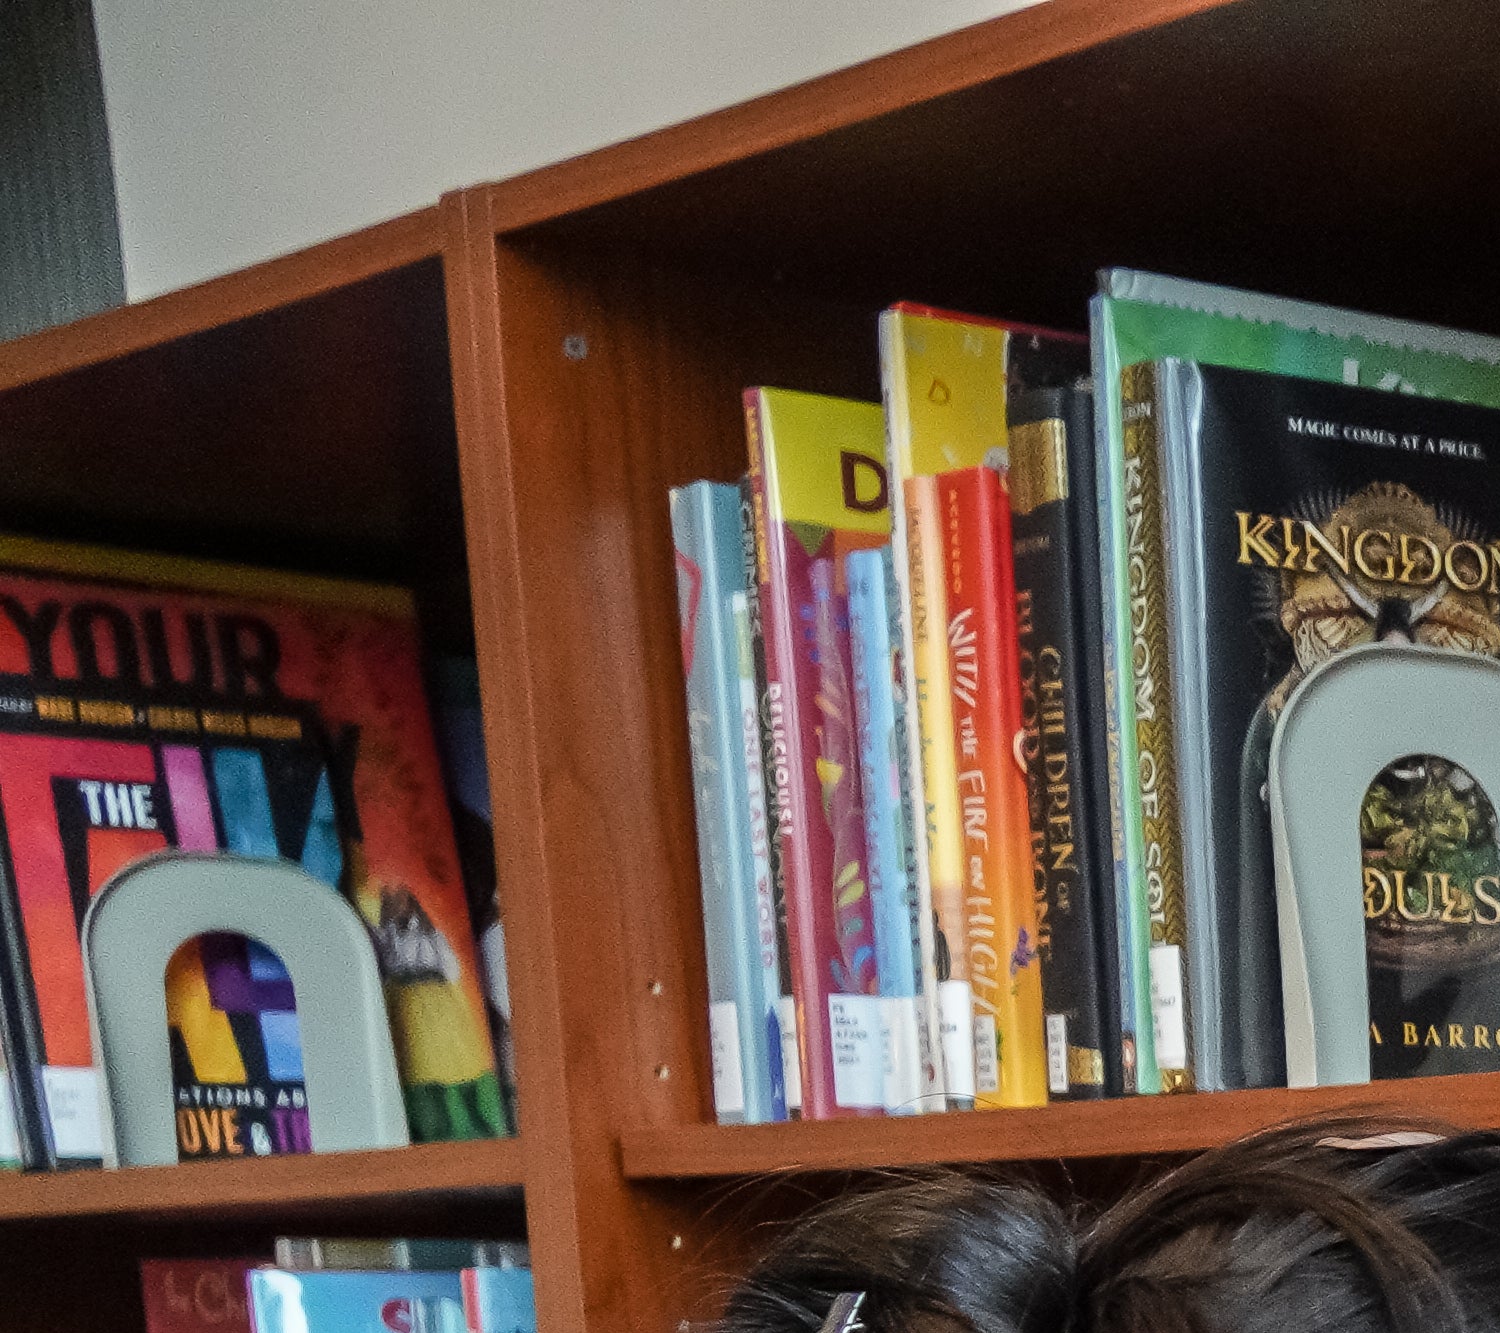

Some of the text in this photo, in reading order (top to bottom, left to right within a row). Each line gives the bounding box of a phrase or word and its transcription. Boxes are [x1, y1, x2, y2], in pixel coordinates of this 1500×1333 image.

[1288, 416, 1397, 448] MAGIC COMES
[1033, 646, 1076, 872] CHILDREN
[77, 779, 157, 830] THE
[958, 770, 992, 851] FIRE
